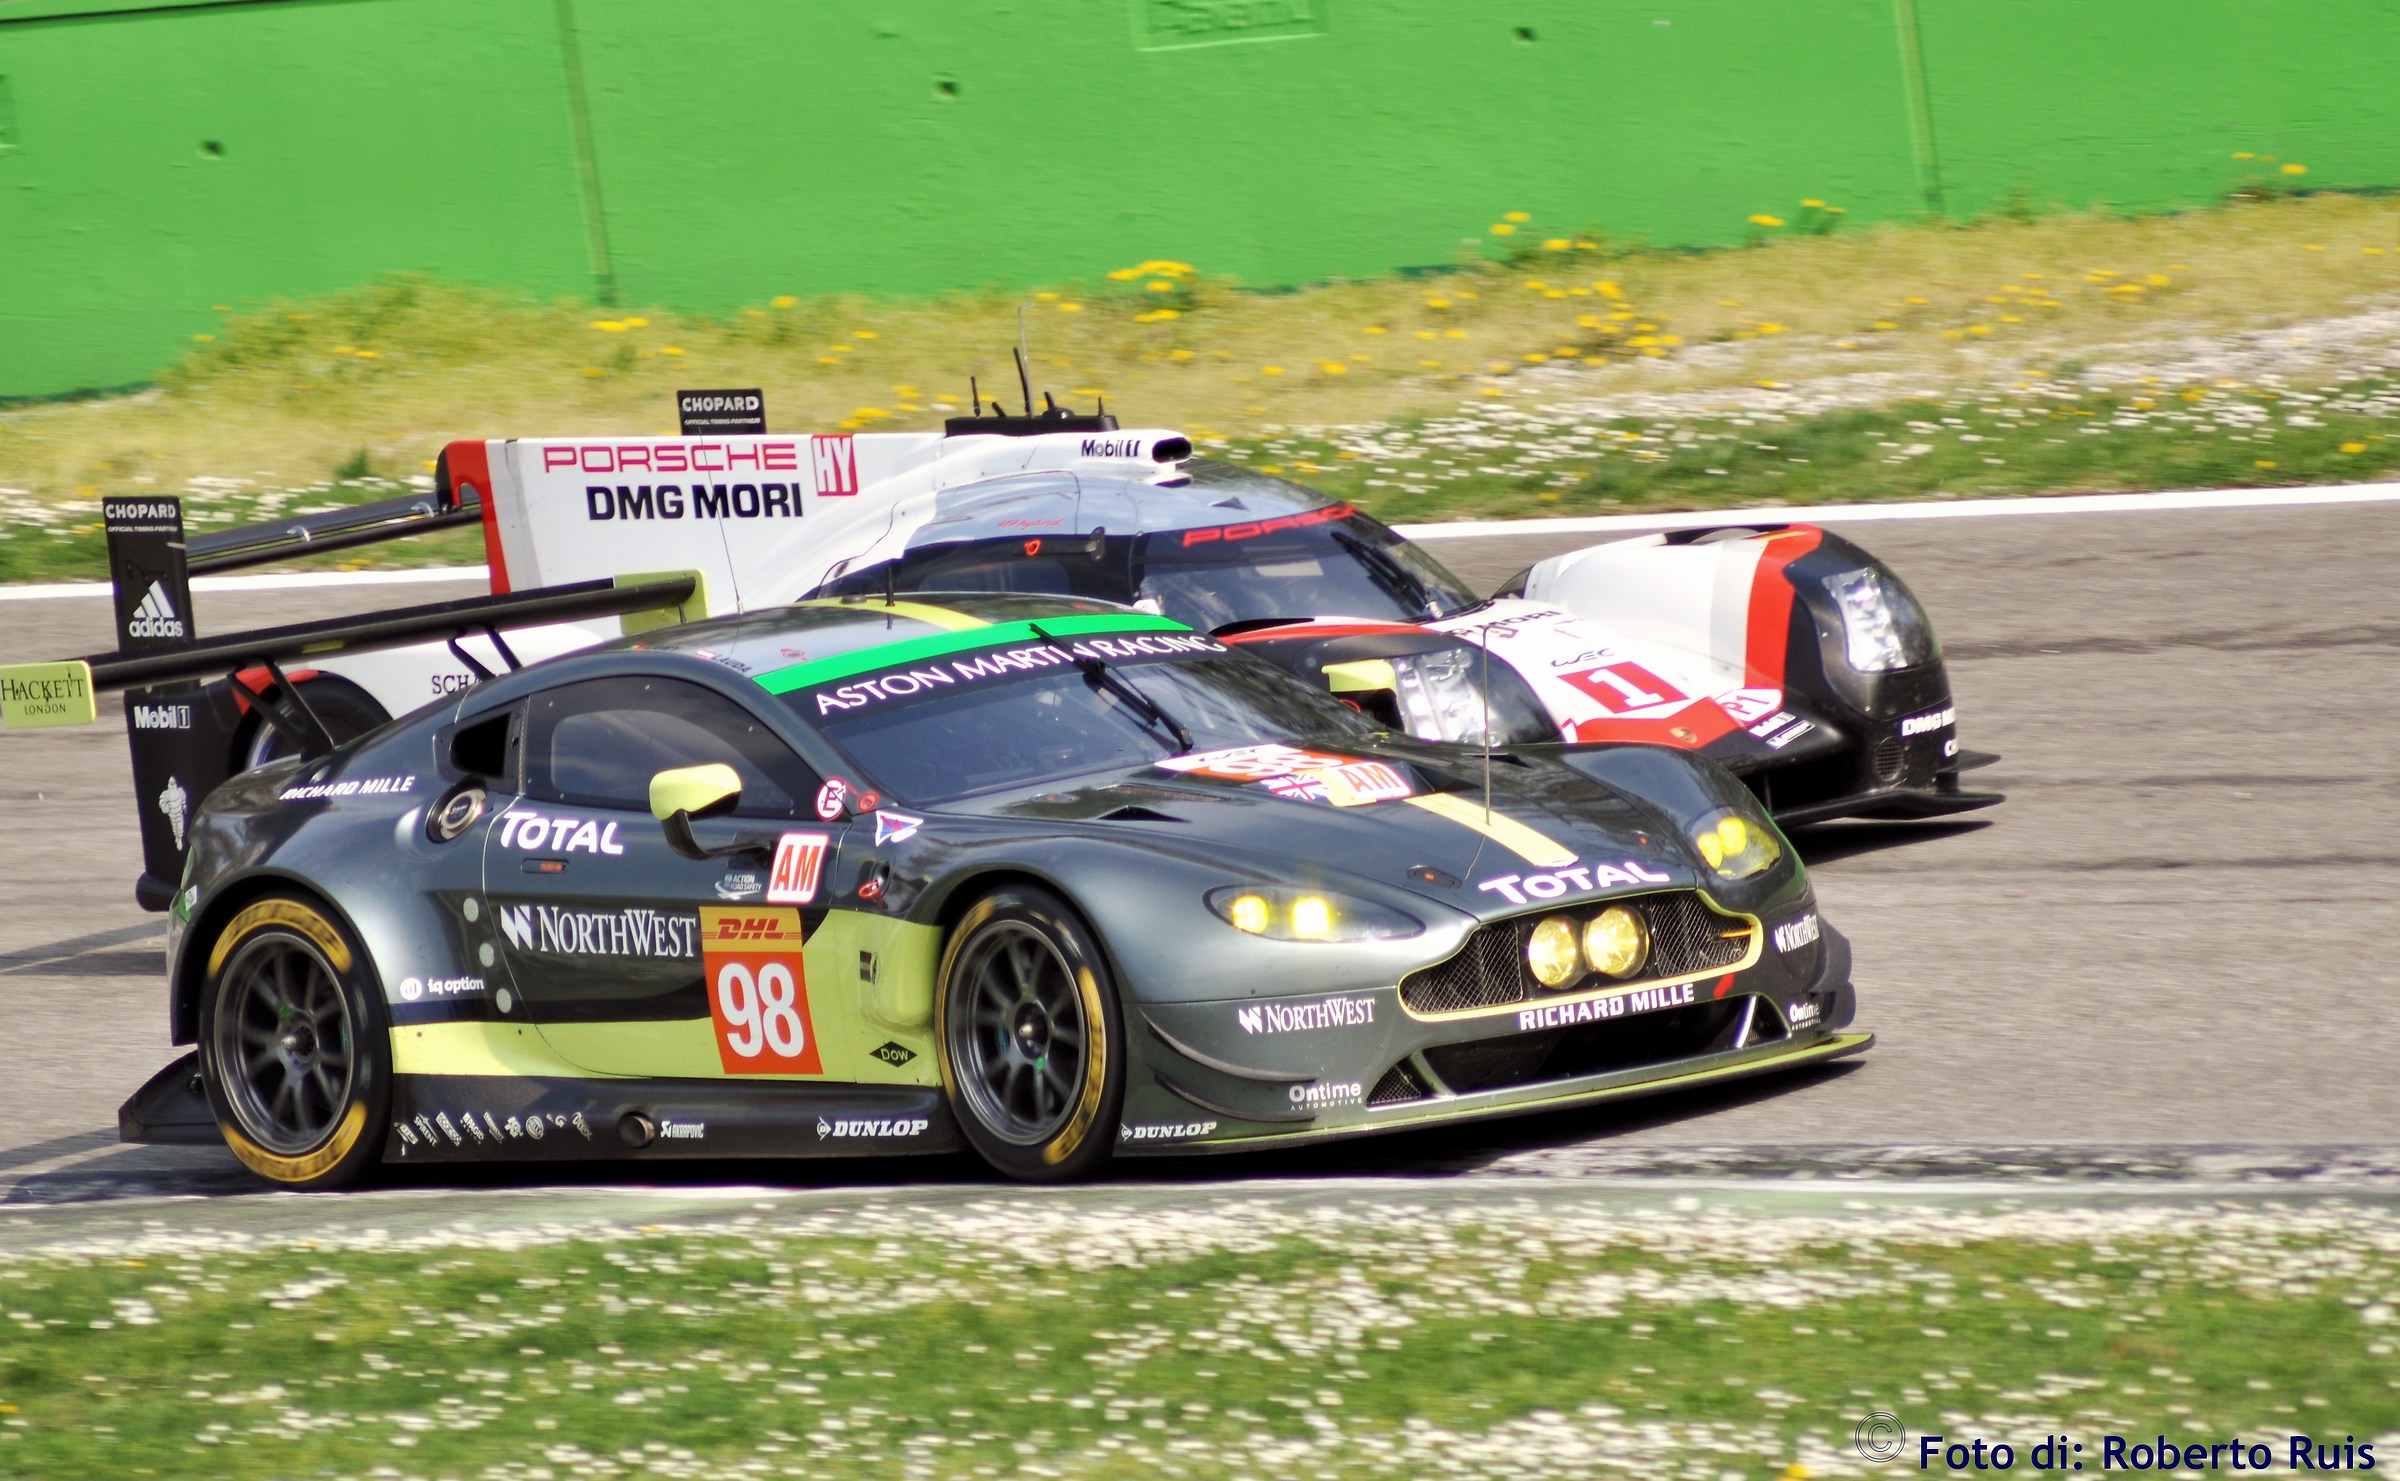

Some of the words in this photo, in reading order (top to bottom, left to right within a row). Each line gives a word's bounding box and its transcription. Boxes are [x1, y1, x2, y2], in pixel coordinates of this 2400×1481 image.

[682, 395, 760, 412] CHOPARD
[543, 443, 798, 473] PORSCHE
[811, 436, 856, 495] HY
[105, 504, 176, 519] CHOPARD
[585, 484, 684, 520] DMG
[691, 482, 803, 519] MORI
[129, 617, 183, 637] adidas
[815, 666, 953, 715] ASTON
[952, 642, 1100, 680] MARTIN
[1098, 634, 1227, 658] RACING
[1, 677, 84, 702] HACKETT
[1587, 668, 1664, 708] 1
[24, 703, 66, 716] LONDON
[1902, 712, 1942, 736] DMG
[279, 781, 359, 800] RICHARD
[359, 776, 415, 794] MILLE
[1342, 764, 1401, 792] AM
[500, 811, 625, 855] TOTAL
[733, 875, 755, 883] ACTION
[773, 845, 821, 892] AM
[1478, 862, 1670, 904] TOTAL
[537, 906, 696, 957] NORTHWEST
[717, 919, 785, 939] DHL
[444, 977, 484, 994] option
[717, 963, 804, 1058] 98
[1265, 998, 1376, 1033] NORTHWEST
[1519, 996, 1624, 1031] RICHARD
[1631, 983, 1695, 1013] MILLE
[880, 1048, 908, 1060] DOW
[1289, 1083, 1361, 1102] Ontime
[1290, 1098, 1362, 1111] AUTOMOTIVE
[464, 1114, 485, 1140] PAGID
[833, 1120, 929, 1136] DUNLOP
[1134, 1121, 1217, 1138] DUNLOP
